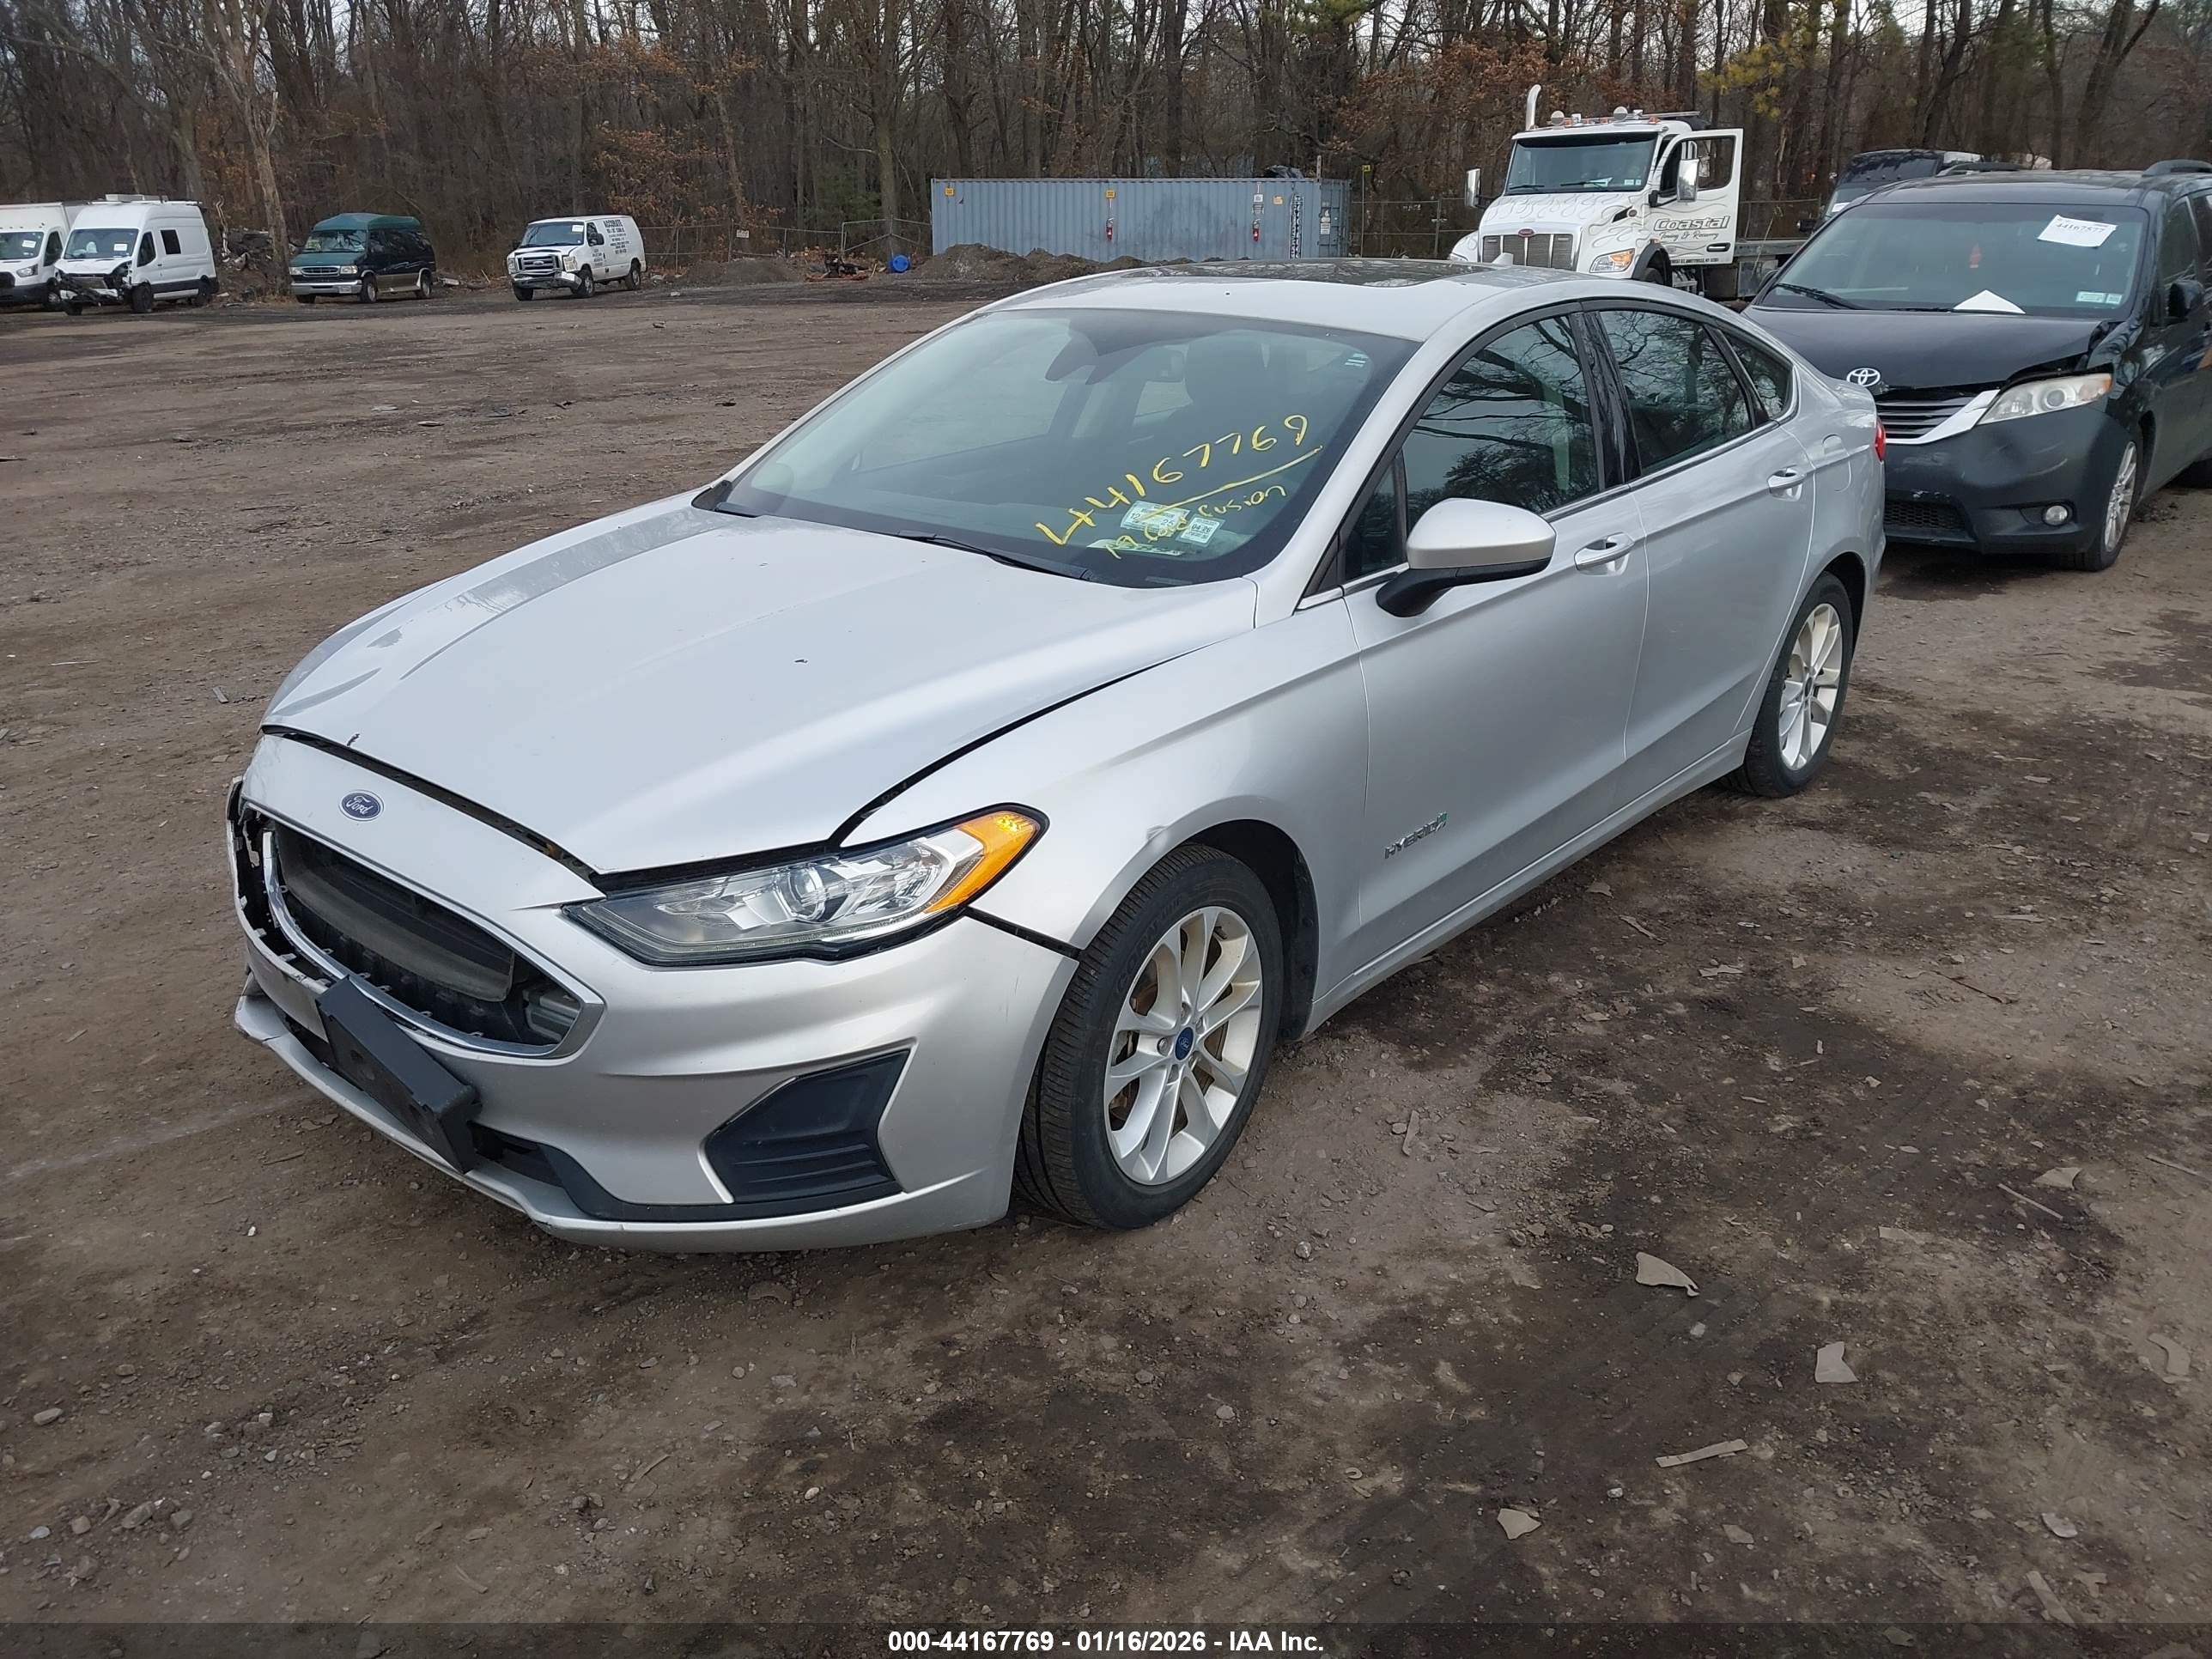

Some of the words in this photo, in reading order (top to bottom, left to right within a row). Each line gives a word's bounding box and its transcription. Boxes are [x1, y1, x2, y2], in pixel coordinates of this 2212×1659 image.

[1654, 216, 1730, 231] Coastal
[1036, 415, 1309, 546] 44167769
[345, 795, 374, 815] Ford
